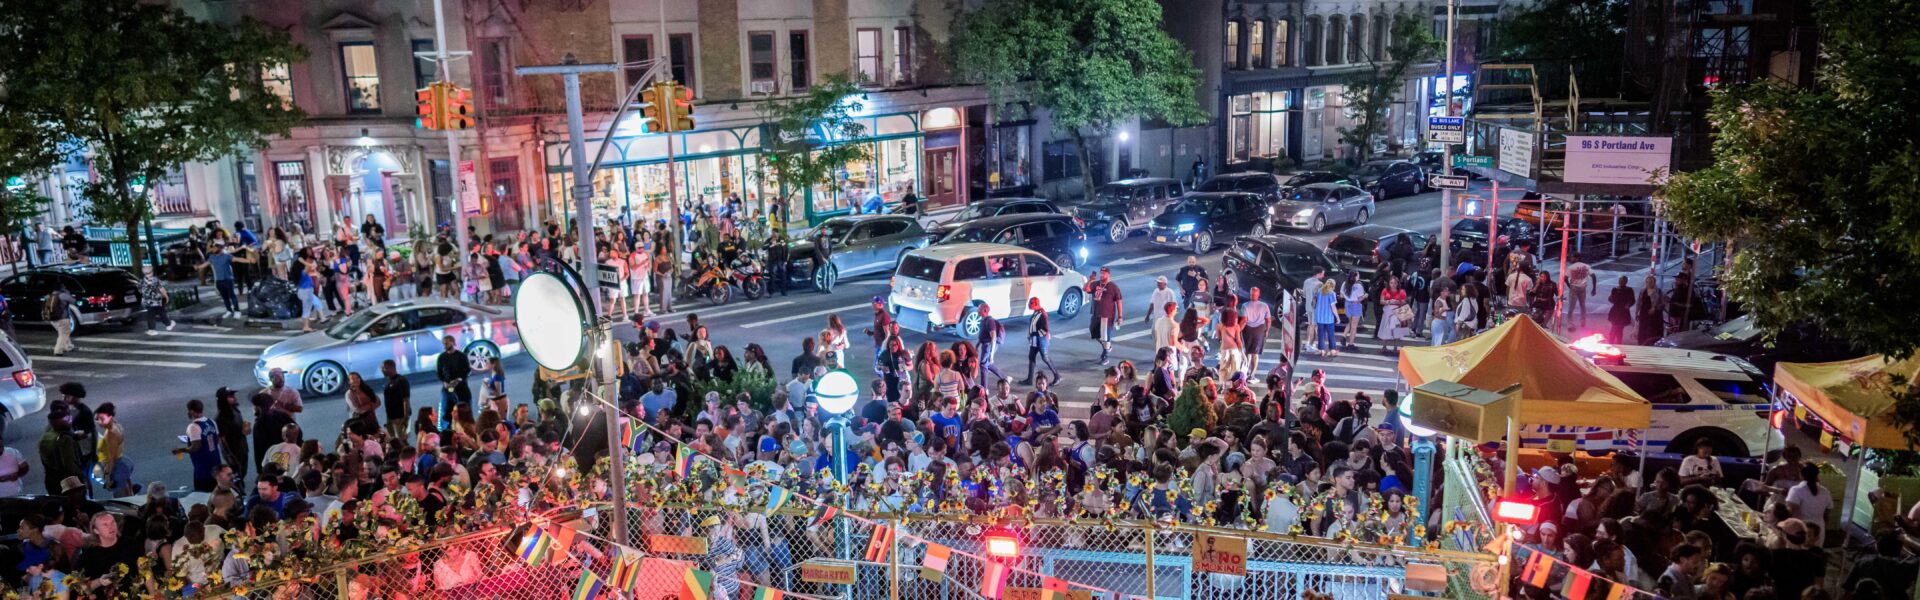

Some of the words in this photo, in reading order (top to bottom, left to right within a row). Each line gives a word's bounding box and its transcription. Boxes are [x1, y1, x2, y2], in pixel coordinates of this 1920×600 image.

[1581, 140, 1592, 149] 96
[1594, 140, 1599, 149] S
[1601, 140, 1638, 150] Portland
[1639, 141, 1655, 151] Ave
[1463, 156, 1488, 164] Portland
[602, 271, 615, 281] WAY
[1218, 551, 1241, 565] NO
[1195, 562, 1245, 574] SMOKING
[803, 568, 850, 581] MARGARITA
